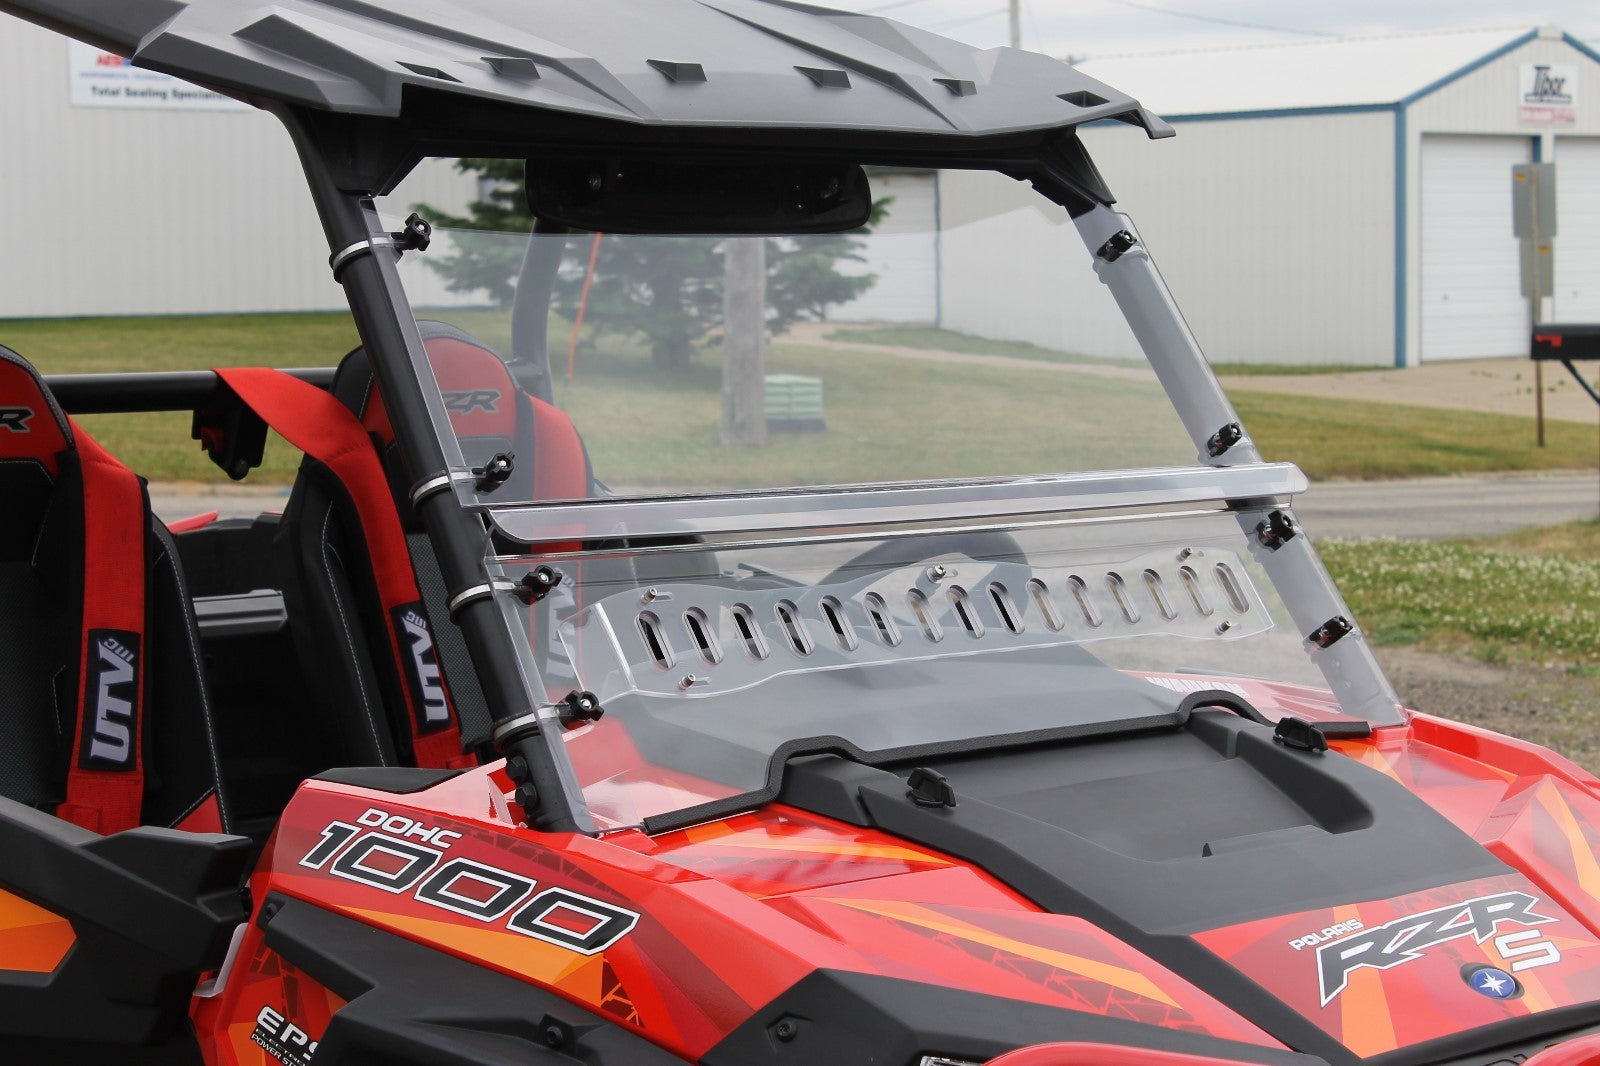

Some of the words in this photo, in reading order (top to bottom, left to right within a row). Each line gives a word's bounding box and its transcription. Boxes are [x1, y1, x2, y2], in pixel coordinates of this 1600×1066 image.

[90, 85, 121, 97] Total
[125, 86, 168, 101] Sealing
[90, 640, 134, 762] UTV
[401, 616, 449, 722] UTV
[356, 807, 463, 849] DOHC
[299, 820, 641, 956] 1000
[1288, 918, 1364, 951] POLARIS
[1315, 890, 1560, 1008] RZR
[1494, 928, 1561, 973] S
[251, 1033, 282, 1060] POWER
